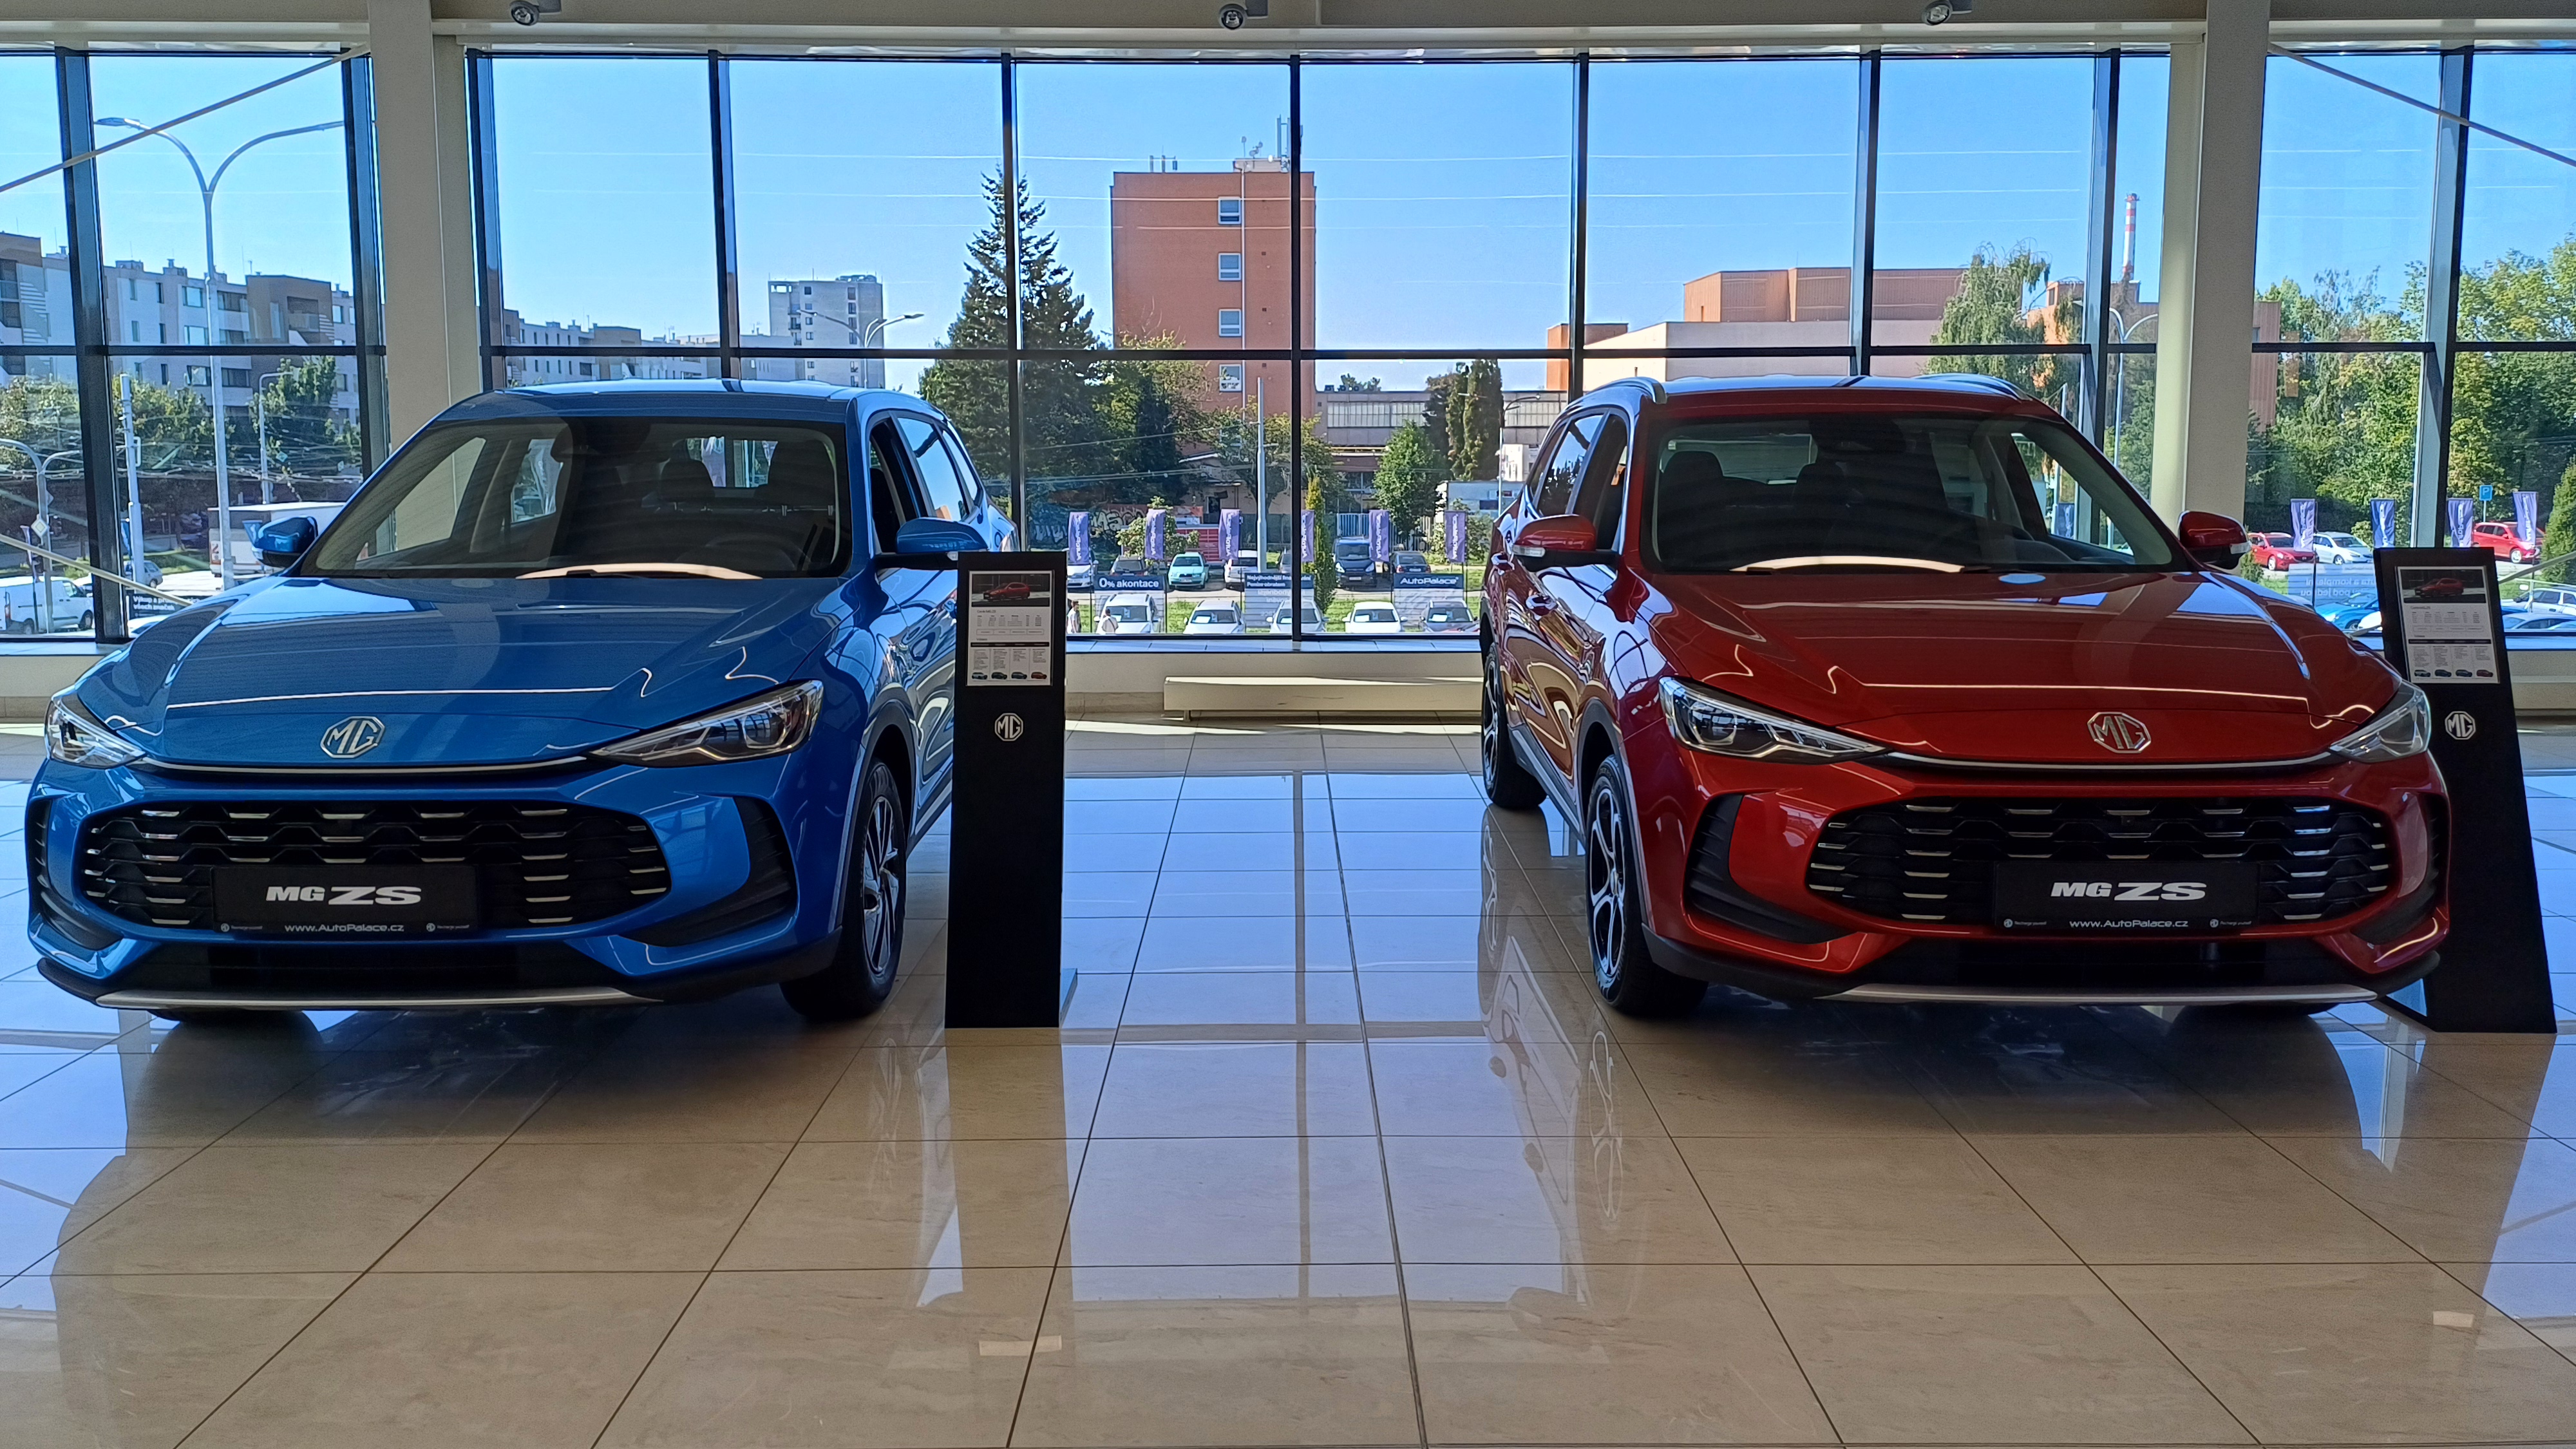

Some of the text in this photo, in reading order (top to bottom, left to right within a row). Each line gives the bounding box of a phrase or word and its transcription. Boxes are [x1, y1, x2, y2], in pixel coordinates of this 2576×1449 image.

[2483, 487, 2490, 496] P
[1099, 578, 1115, 587] 0%
[996, 715, 1022, 740] MG
[2092, 715, 2146, 750] MG
[2447, 713, 2474, 738] MG
[325, 719, 380, 754] MG
[266, 886, 422, 905] MG ZS
[2050, 882, 2206, 900] MG ZS
[285, 923, 404, 933] www.AutoPalace.cz
[2069, 920, 2188, 928] www.AutoPalace.cz
